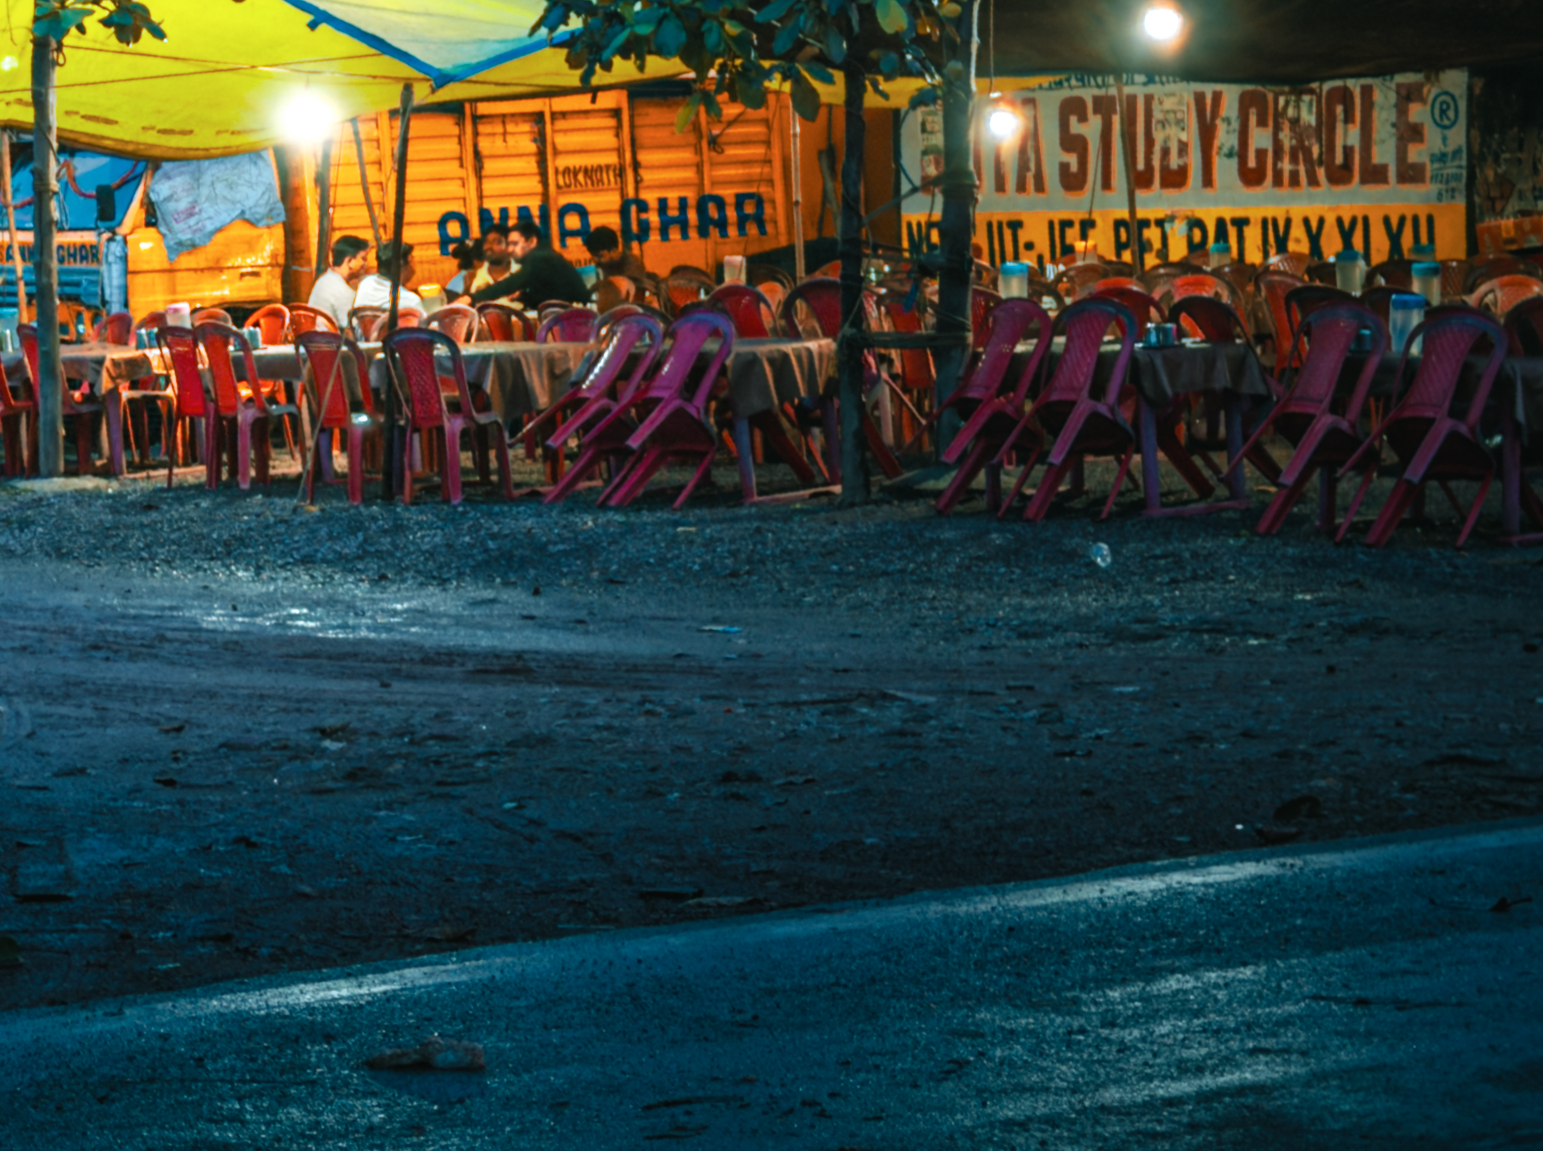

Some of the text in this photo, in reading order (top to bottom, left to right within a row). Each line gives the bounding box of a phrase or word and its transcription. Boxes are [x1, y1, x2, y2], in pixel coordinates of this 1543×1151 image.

[1058, 89, 1225, 196] STUDY
[1238, 80, 1431, 191] CIRCLE
[619, 191, 768, 247] GHAR
